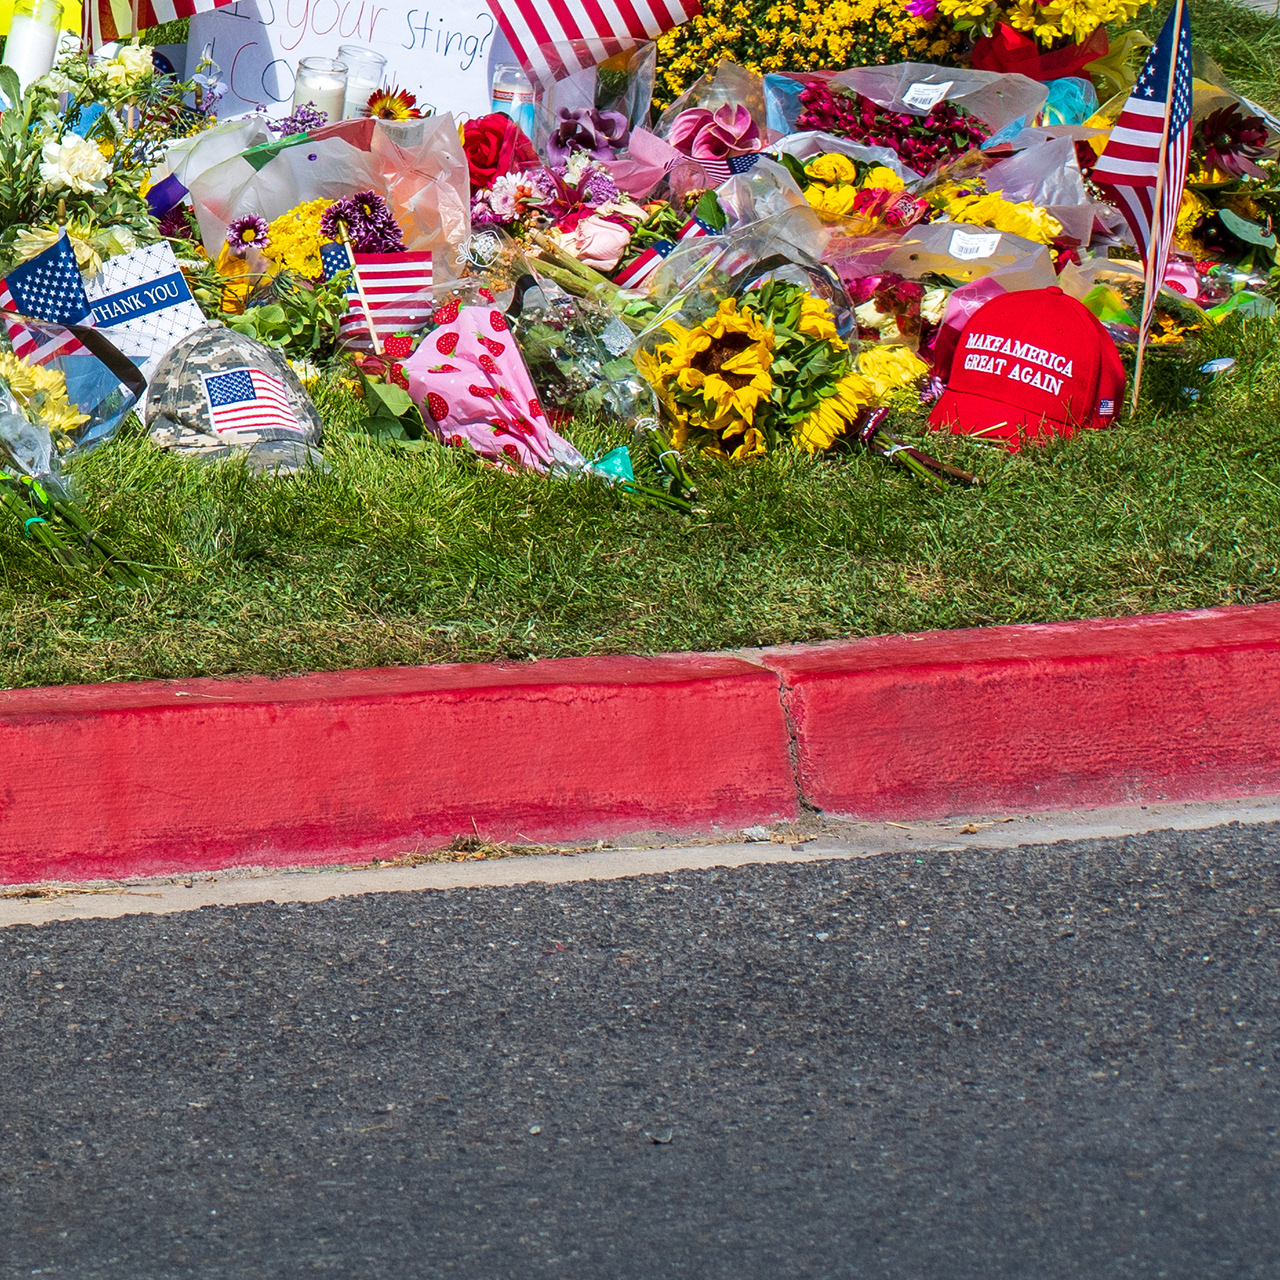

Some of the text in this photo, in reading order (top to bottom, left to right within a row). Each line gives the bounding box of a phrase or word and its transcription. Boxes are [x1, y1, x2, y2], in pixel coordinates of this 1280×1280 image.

[91, 281, 179, 324] THANK YOU
[964, 354, 1064, 396] GREAT AGAIN
[965, 333, 1073, 378] MAKE AMERICA
